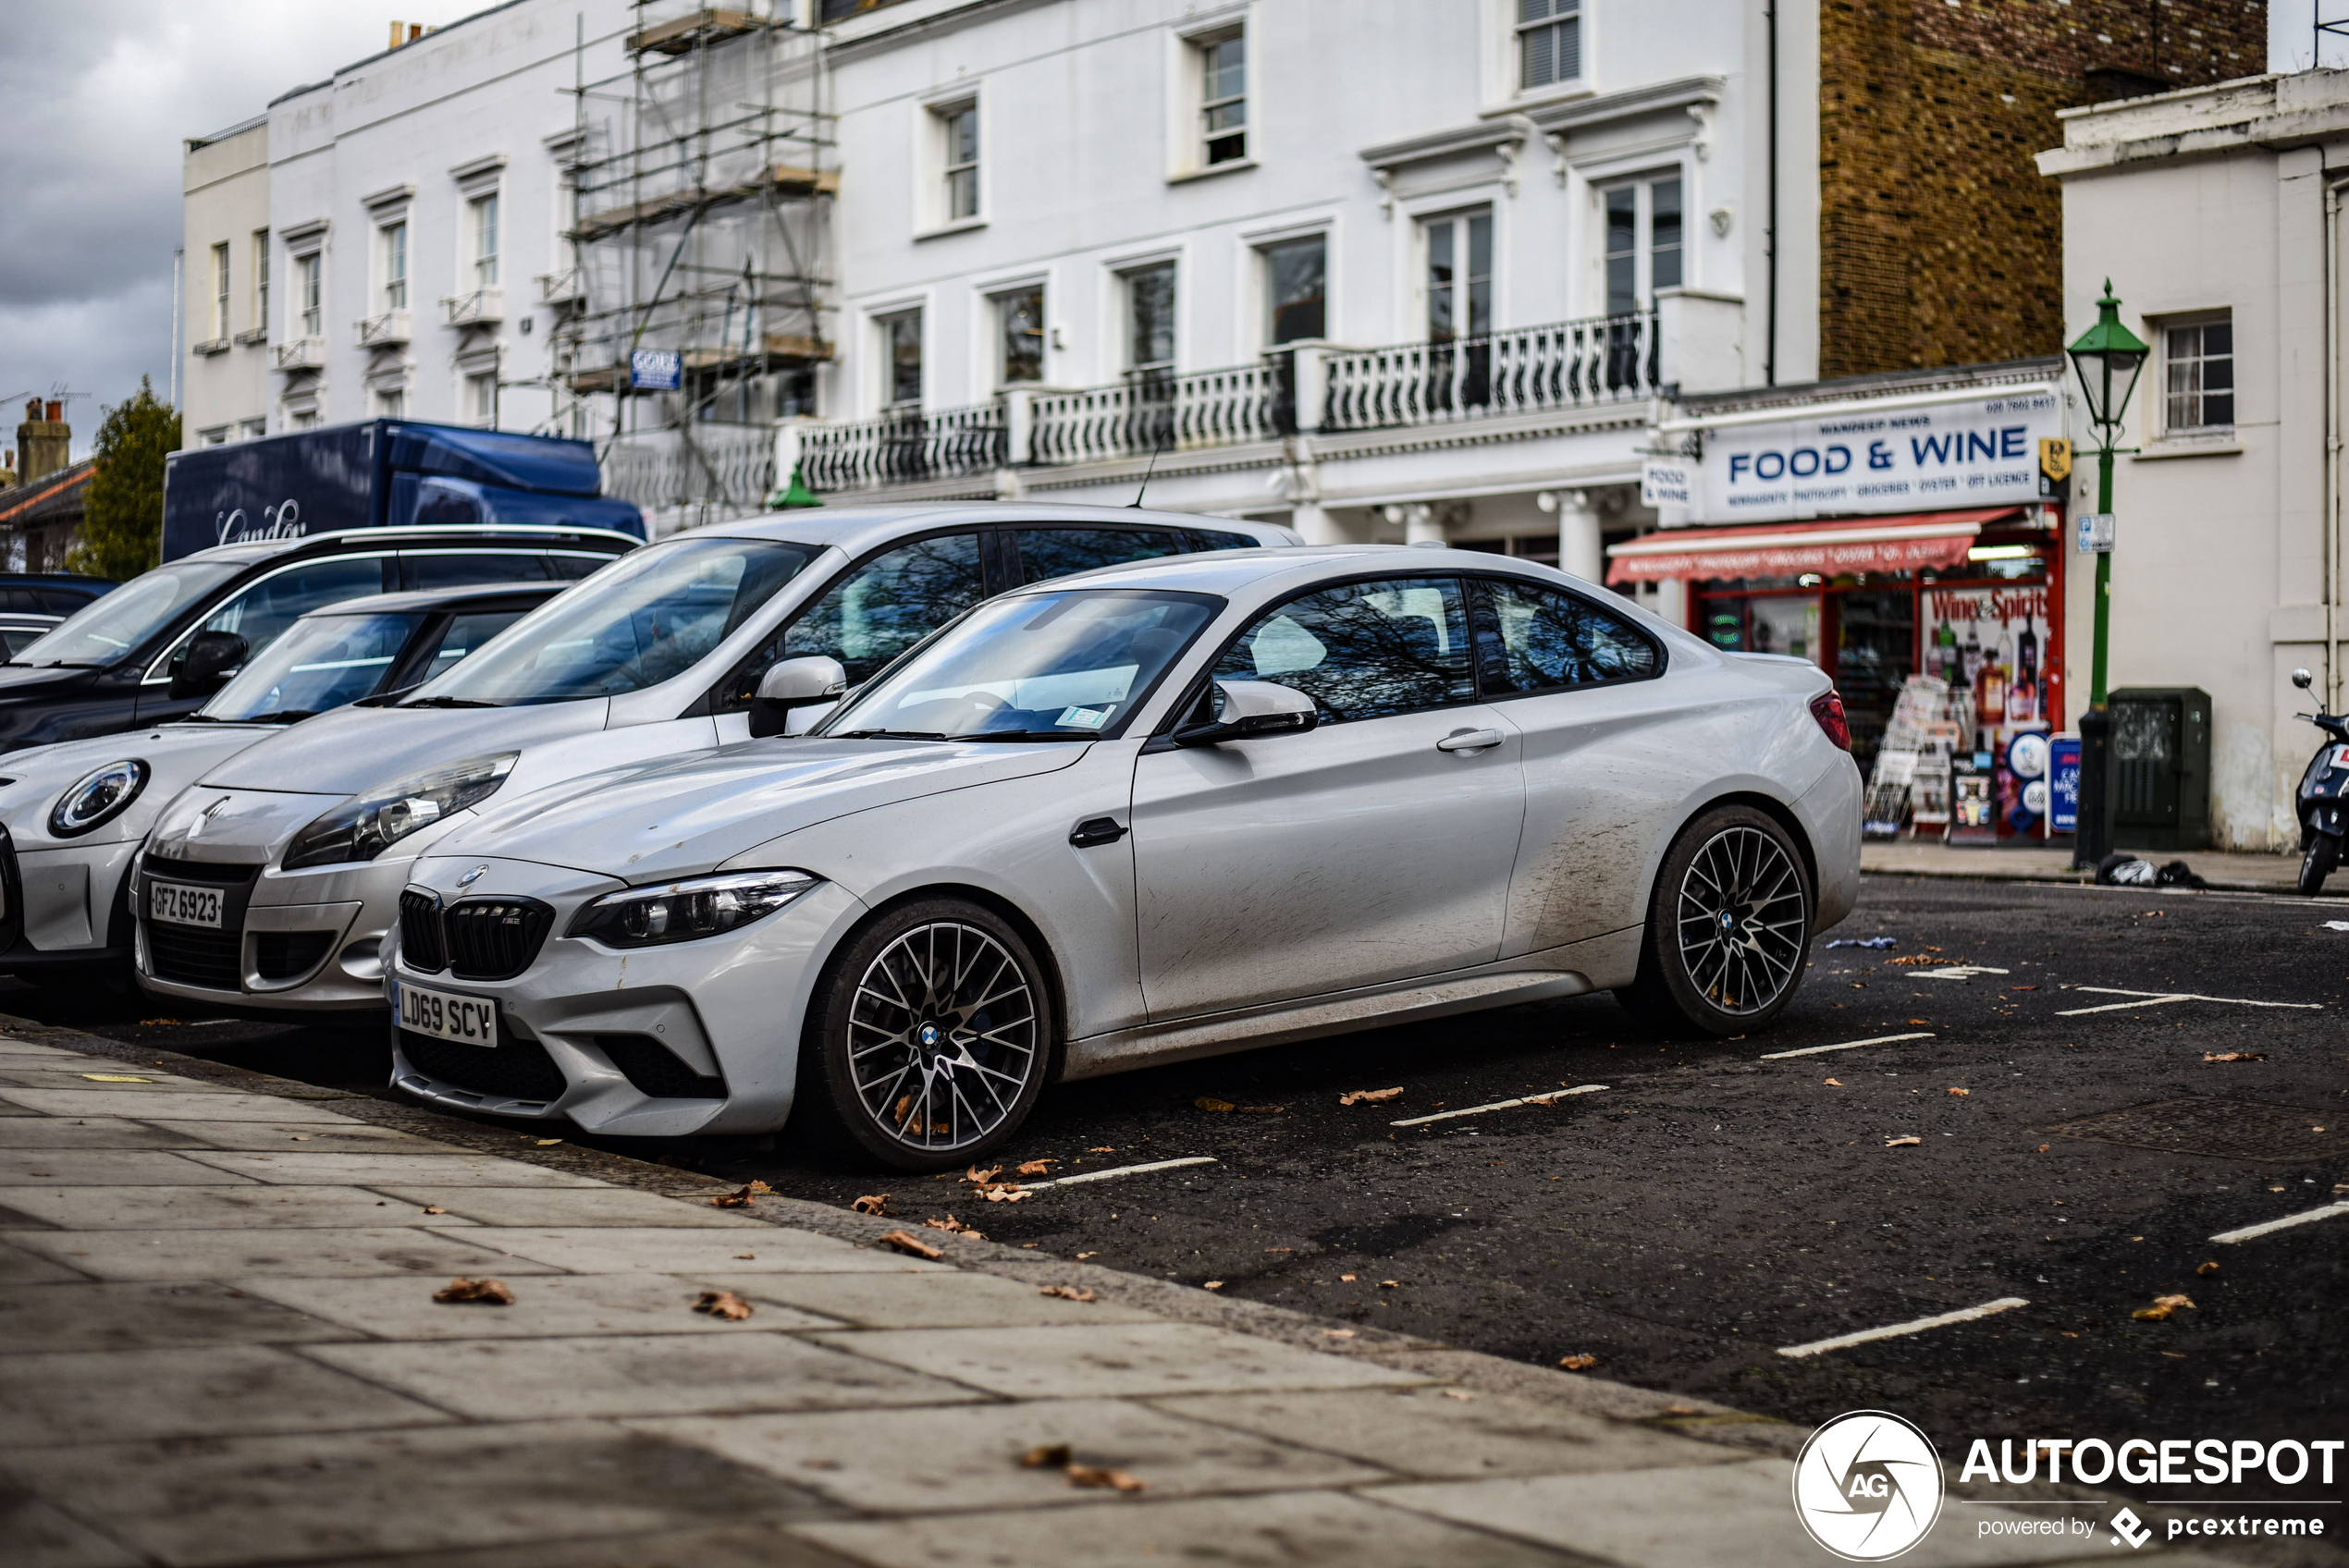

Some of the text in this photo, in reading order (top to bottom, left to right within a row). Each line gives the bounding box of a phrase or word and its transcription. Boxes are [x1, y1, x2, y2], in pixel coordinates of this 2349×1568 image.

[1889, 415, 1930, 430] NEWS
[1728, 424, 2028, 484] FOOD & WINE
[1649, 469, 1686, 484] FOOD
[1920, 475, 1957, 493] OYSTER
[1988, 471, 2030, 486] LICENCE
[1657, 487, 1689, 502] WINE
[1931, 590, 1979, 621] Wine
[155, 887, 216, 923] GFZ 6923
[400, 988, 490, 1039] LD69 SCV
